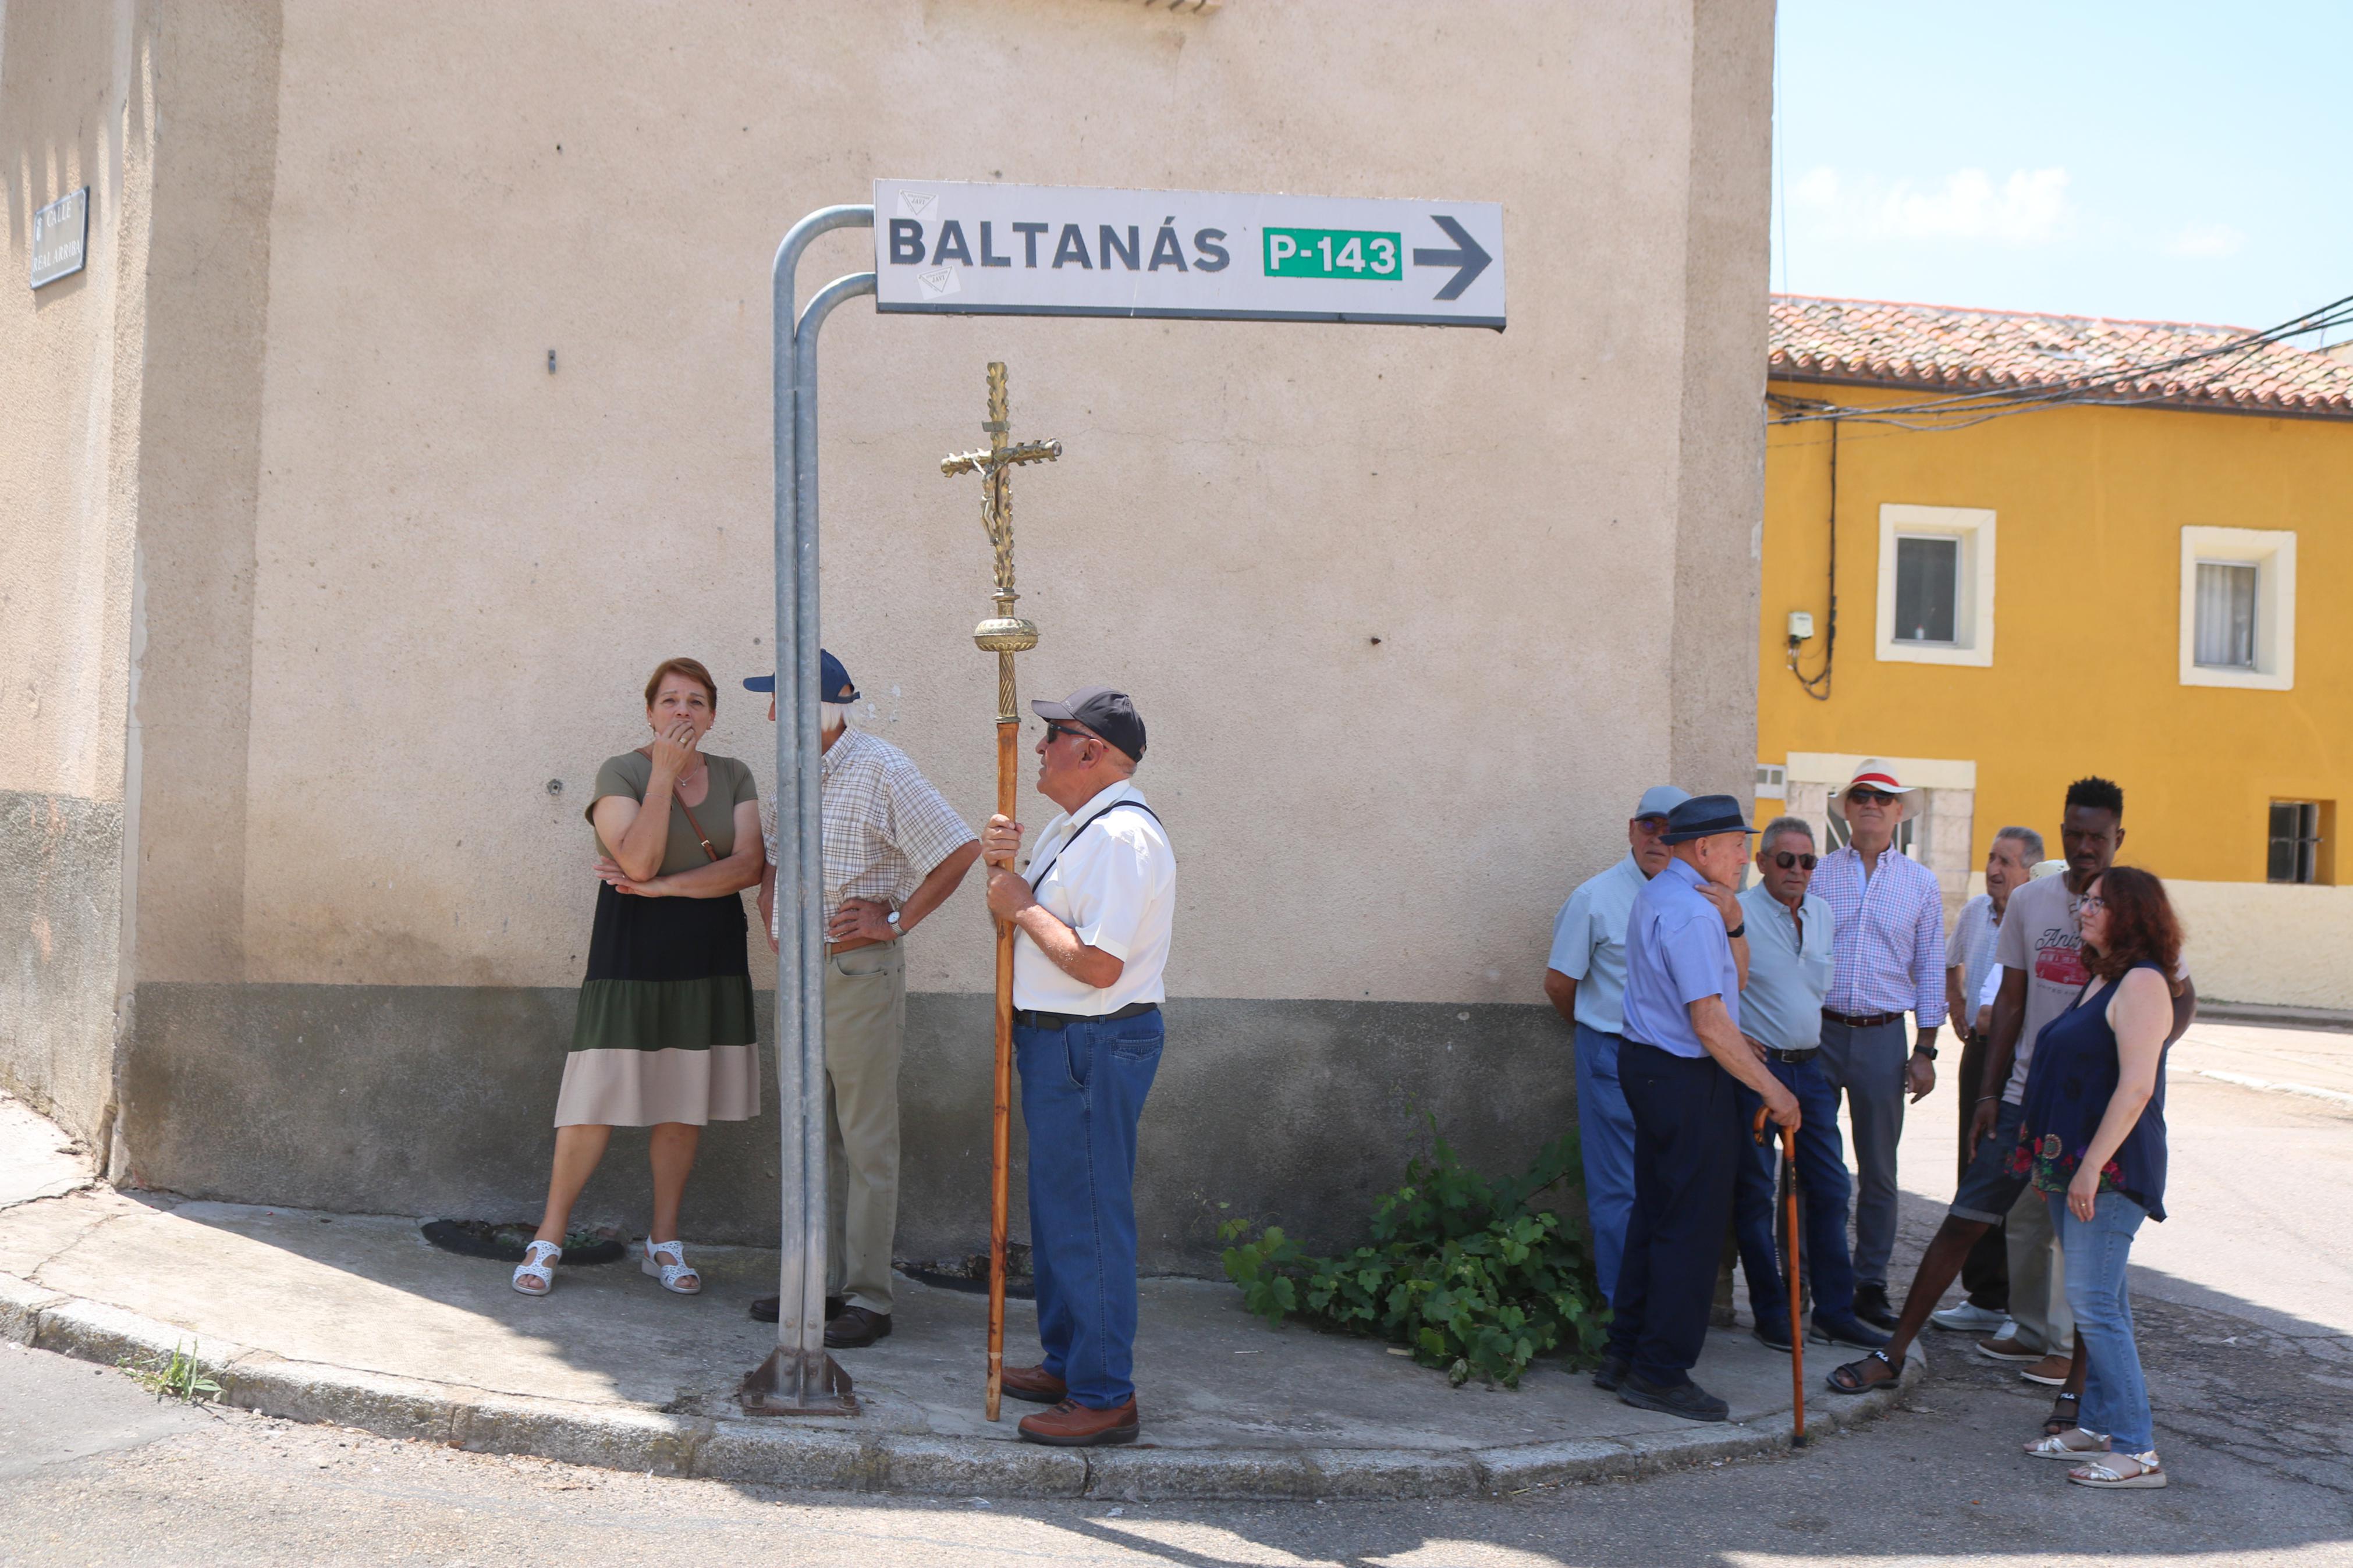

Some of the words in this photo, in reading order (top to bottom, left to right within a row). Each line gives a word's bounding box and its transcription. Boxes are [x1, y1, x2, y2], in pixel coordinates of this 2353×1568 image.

[47, 201, 72, 227] CALLE
[33, 251, 51, 272] REAL
[53, 240, 80, 263] ARRIBA
[889, 216, 1230, 272] BALTANÁS
[1270, 234, 1396, 274] P-143
[932, 275, 945, 283] JAVI
